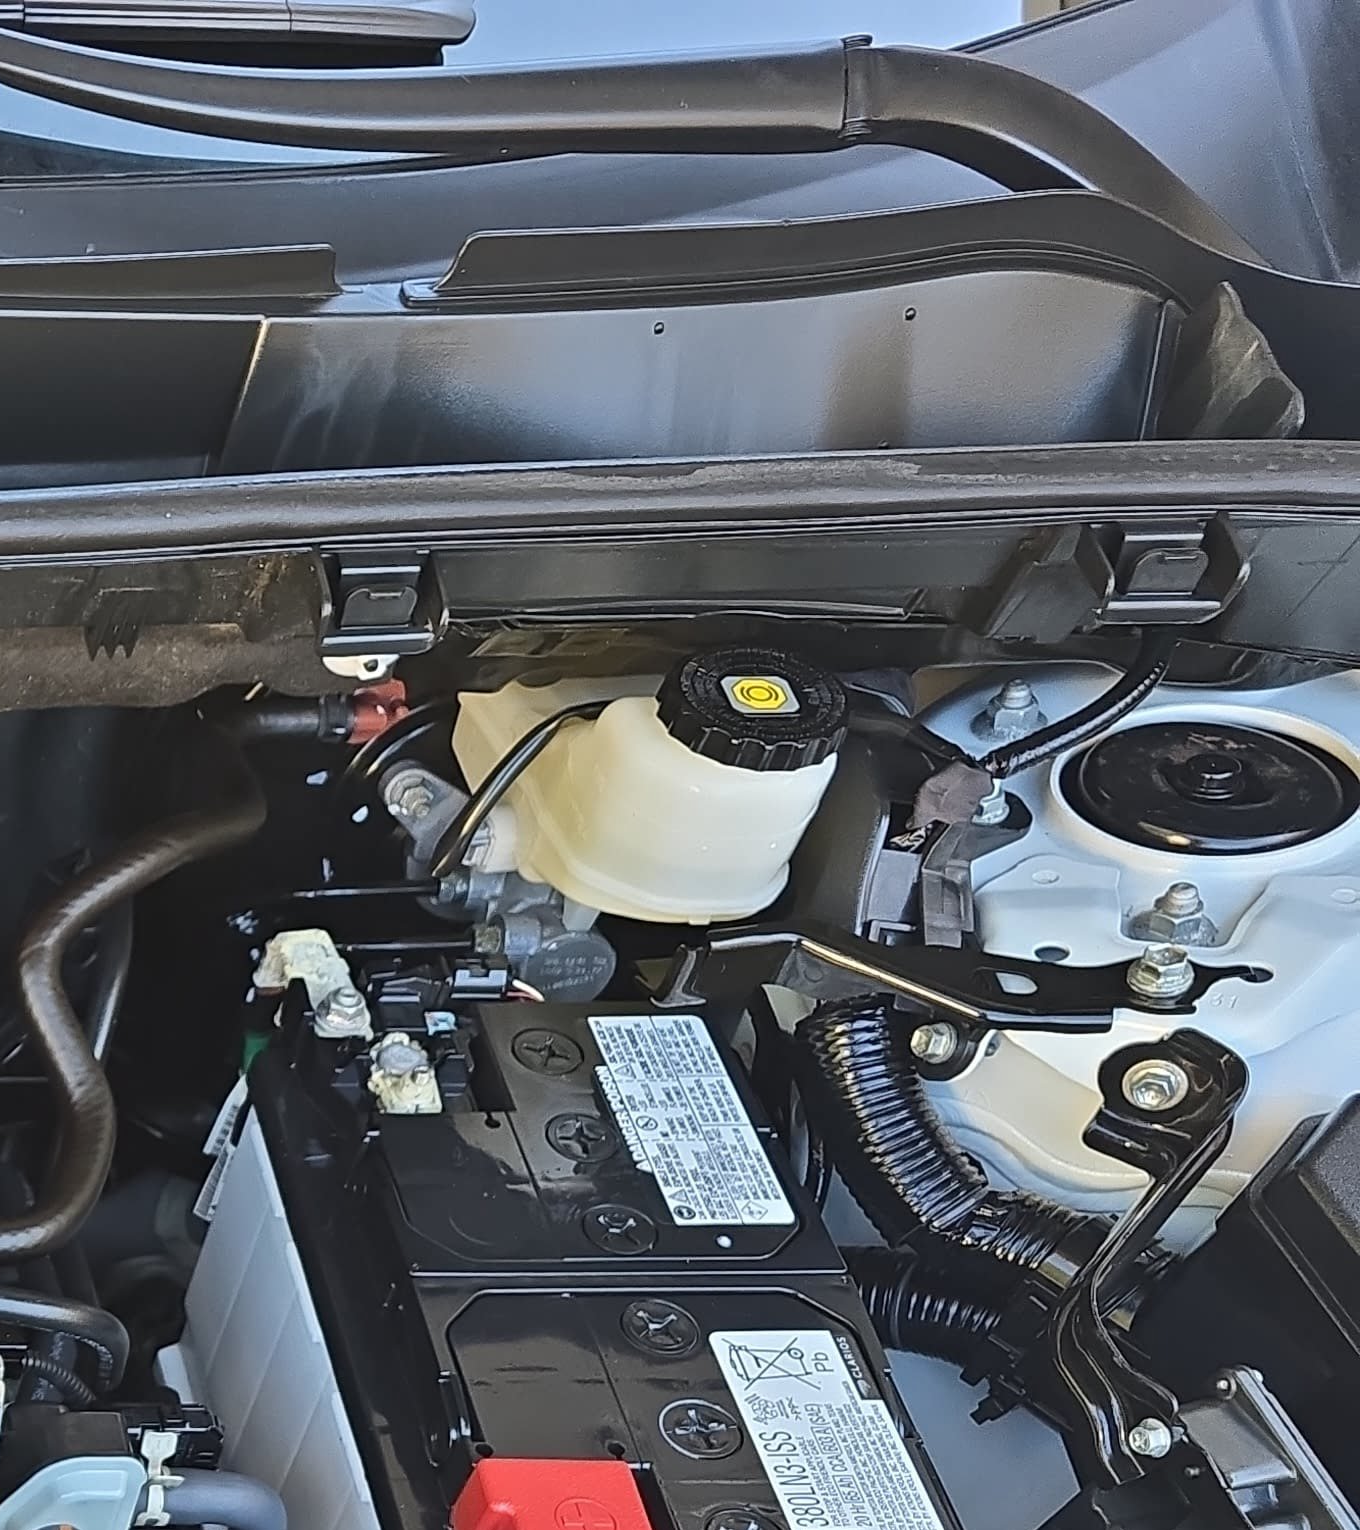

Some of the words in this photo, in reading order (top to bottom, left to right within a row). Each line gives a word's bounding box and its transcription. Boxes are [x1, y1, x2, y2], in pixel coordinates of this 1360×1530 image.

[595, 1065, 624, 1111] POISON
[614, 1111, 646, 1161] DANGER
[809, 1351, 835, 1372] Pb
[836, 1337, 864, 1379] CLARIOS
[758, 1431, 828, 1527] 380LN3-ISS
